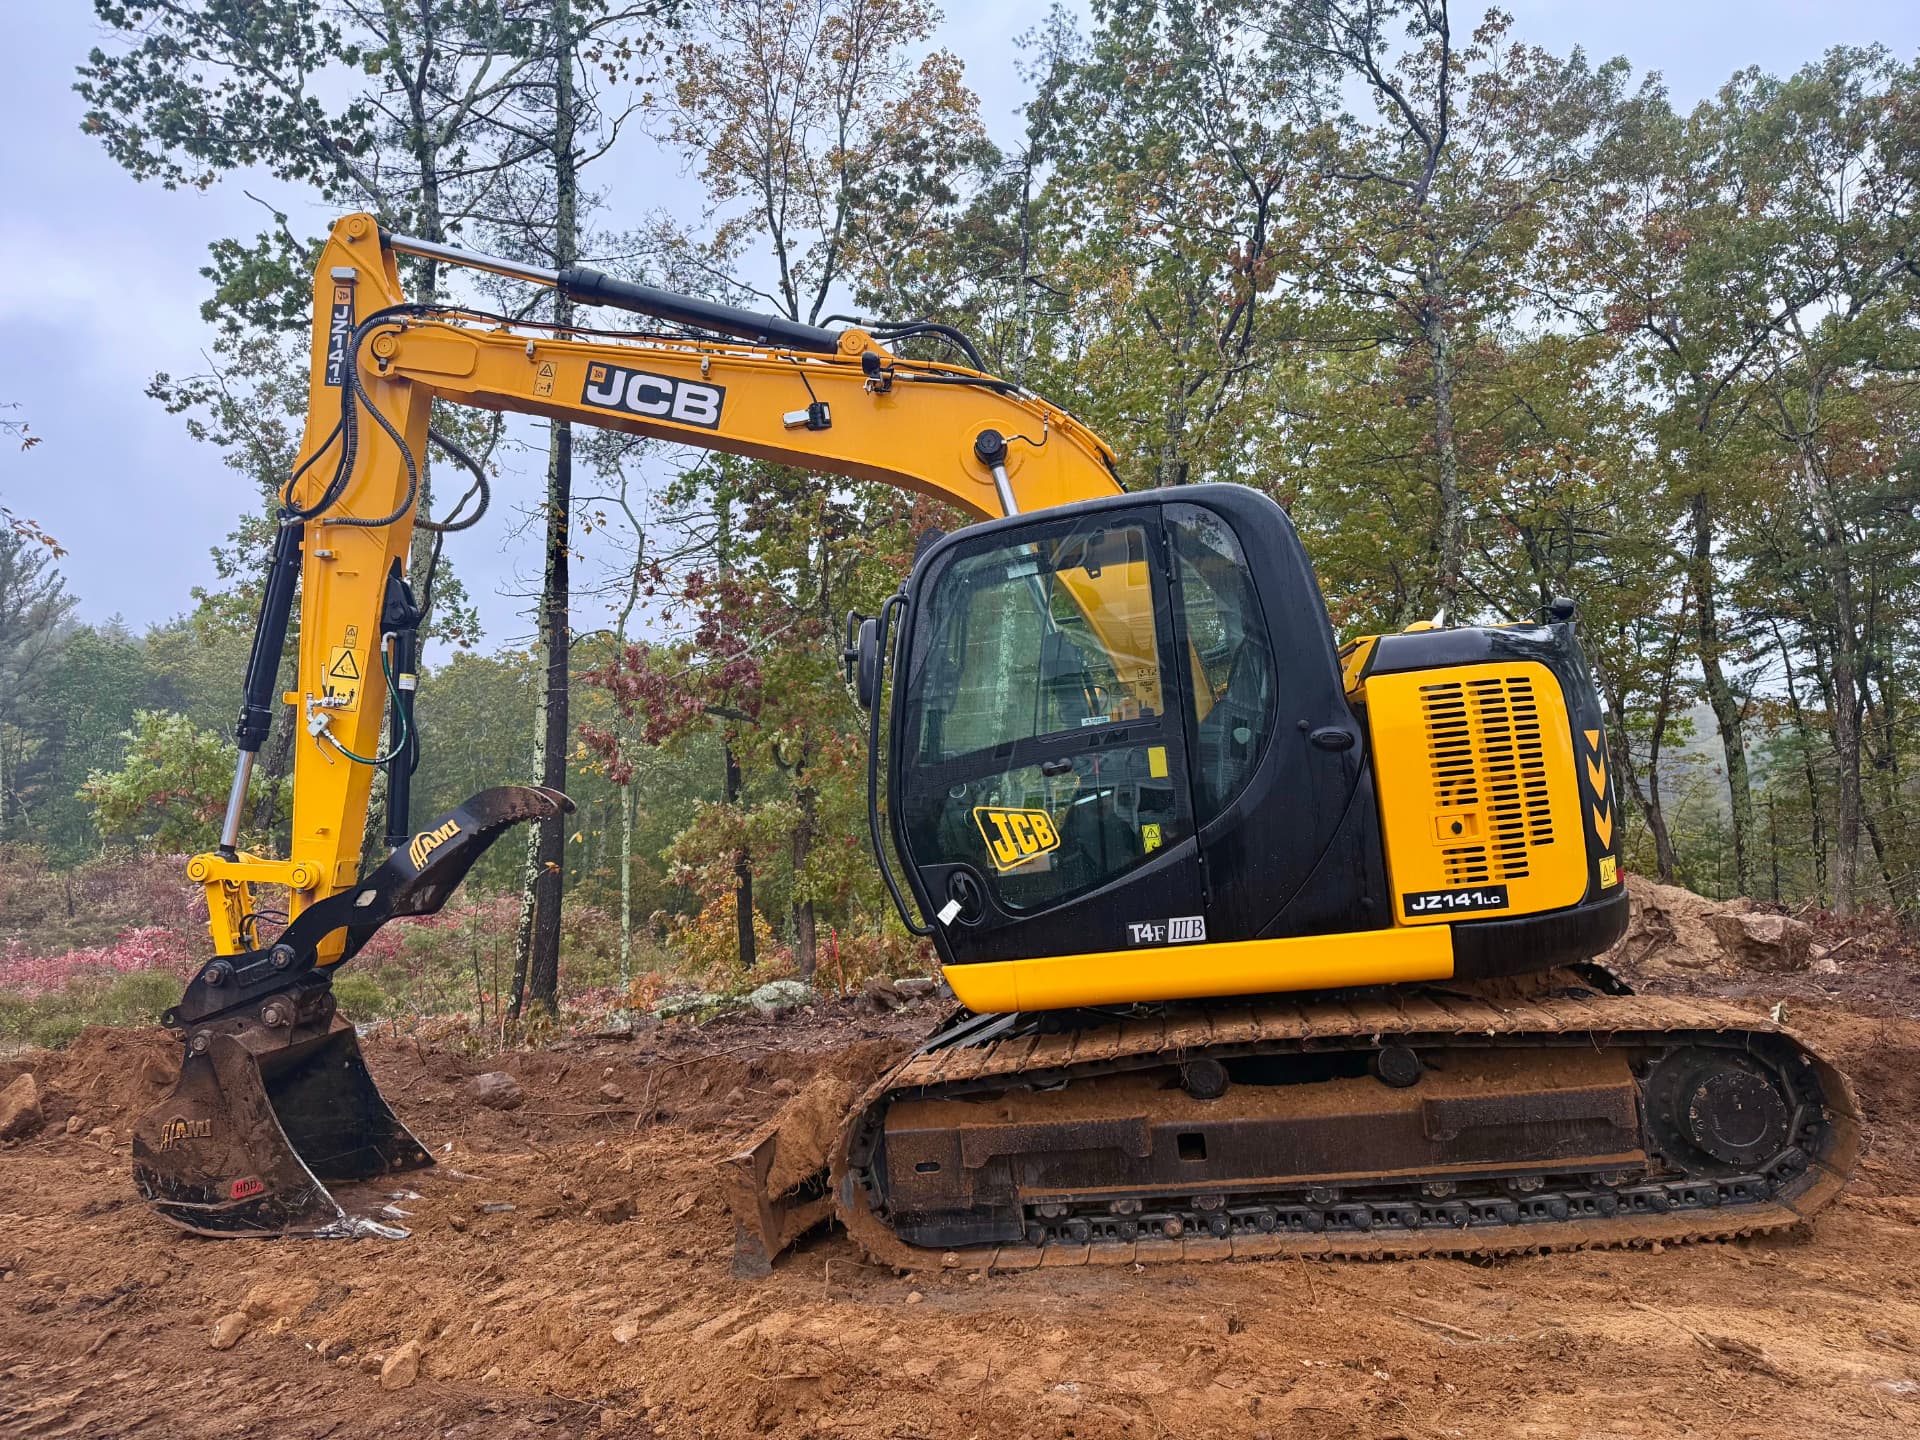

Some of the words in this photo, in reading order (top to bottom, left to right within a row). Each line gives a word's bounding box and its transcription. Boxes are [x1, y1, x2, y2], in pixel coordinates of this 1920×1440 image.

[587, 370, 720, 424] JCB
[988, 813, 1054, 863] JCB
[1128, 923, 1166, 943] T4F
[236, 1180, 258, 1193] HDD
